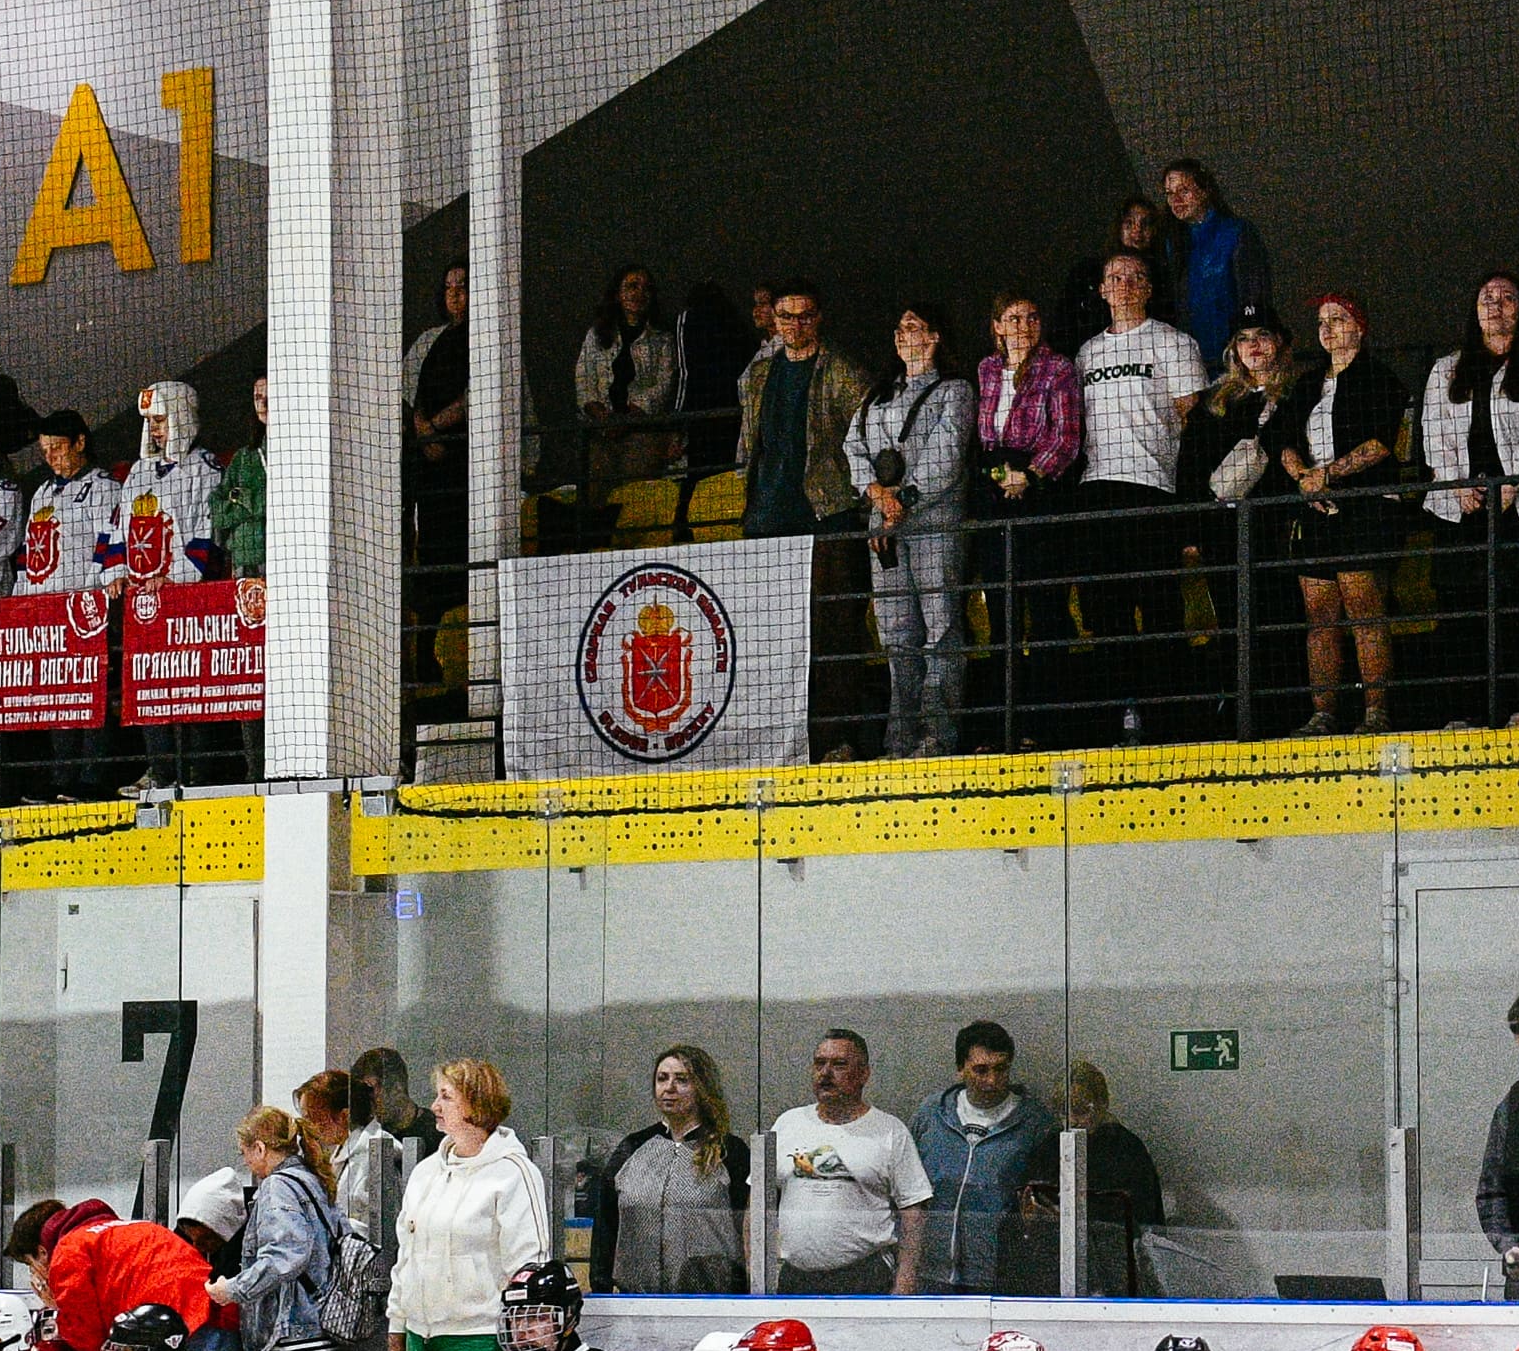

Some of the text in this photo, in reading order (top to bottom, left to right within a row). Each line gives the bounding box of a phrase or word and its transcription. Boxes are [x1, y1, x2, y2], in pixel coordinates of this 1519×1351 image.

[1084, 363, 1155, 388] ROCODILE
[165, 614, 239, 646] ТУЛЬСКИЕ
[39, 654, 99, 685] ВПЕРЁД!
[132, 650, 201, 681] ПРЯНИКИ
[122, 1000, 198, 1221] 7
